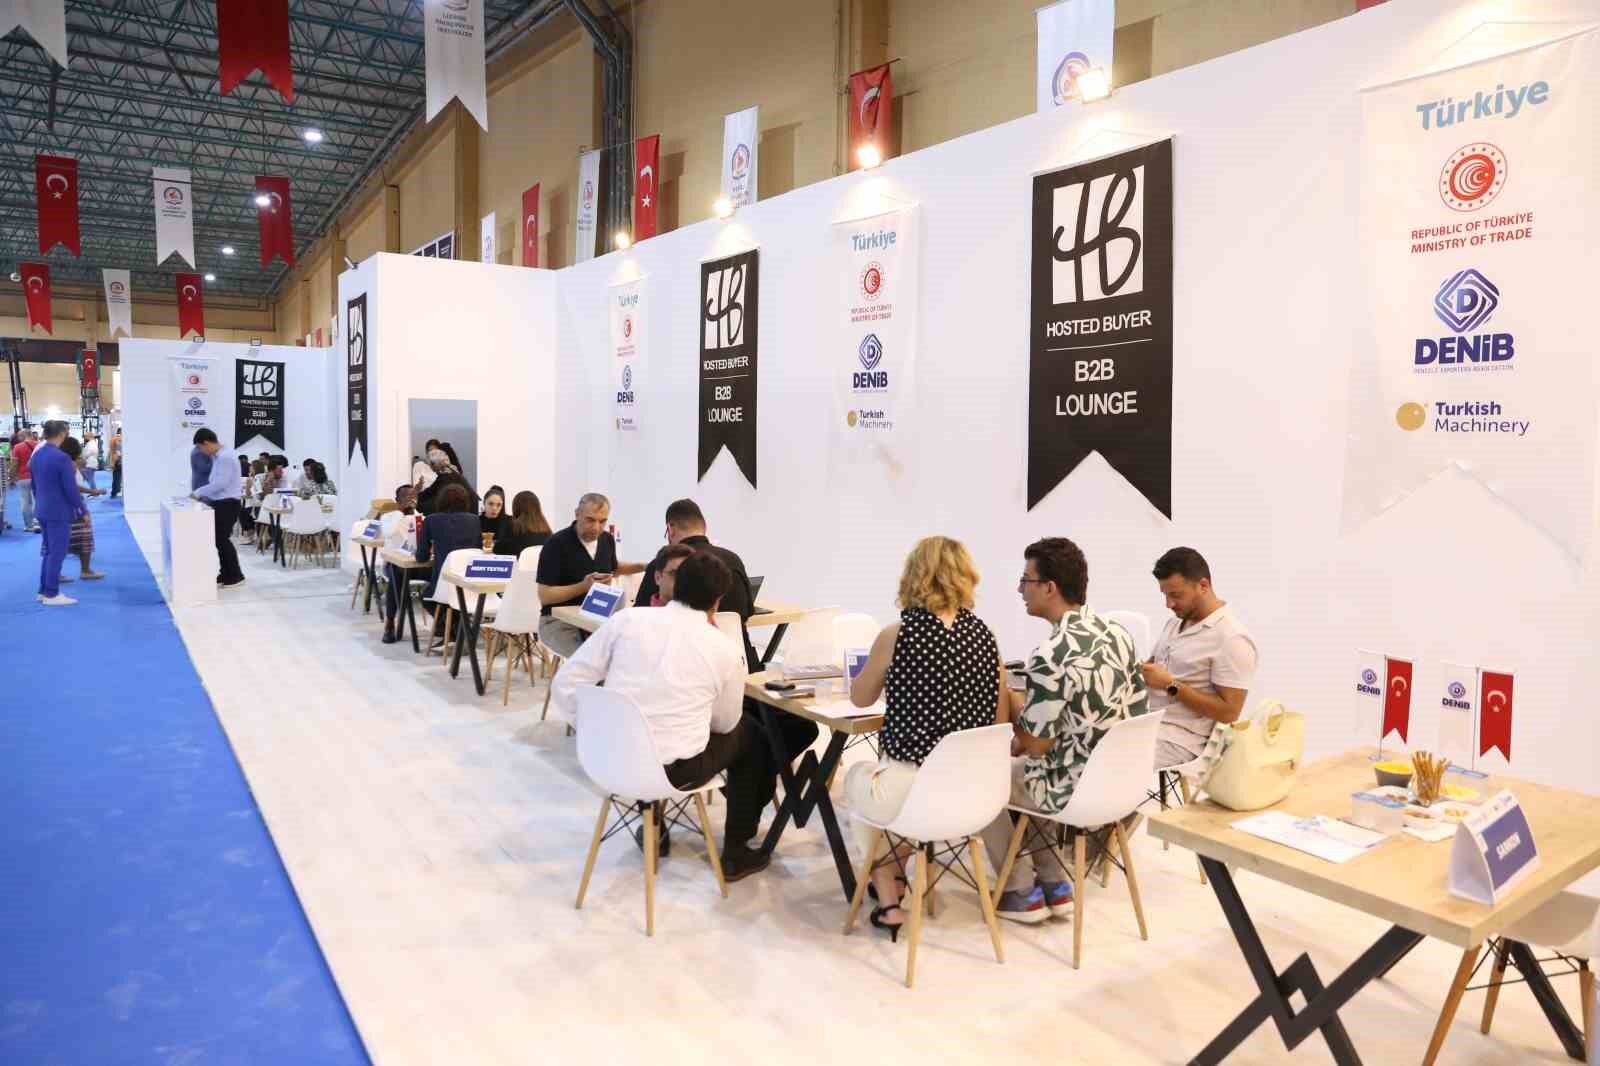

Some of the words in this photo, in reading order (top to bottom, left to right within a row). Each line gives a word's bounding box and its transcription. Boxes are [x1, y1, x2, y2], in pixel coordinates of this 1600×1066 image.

[1416, 80, 1549, 130] Türkiye
[1411, 223, 1463, 240] REPUBLIC
[1465, 220, 1481, 232] OF
[1484, 212, 1534, 229] TÜRKİYE
[852, 230, 897, 251] Türkiye
[1411, 237, 1467, 254] MINISTRY
[1470, 234, 1487, 247] OF
[1490, 227, 1533, 243] TRADE
[1046, 317, 1100, 337] HOSTED
[1102, 310, 1152, 332] BUYER
[1074, 358, 1115, 382] B2B
[715, 385, 732, 400] B2B
[860, 409, 885, 419] Turkish
[1055, 391, 1138, 416] LOUNGE
[1435, 401, 1501, 416] Turkish
[244, 418, 276, 426] LOUNGE
[707, 407, 743, 423] LOUNGE
[1434, 417, 1530, 437] Machinery
